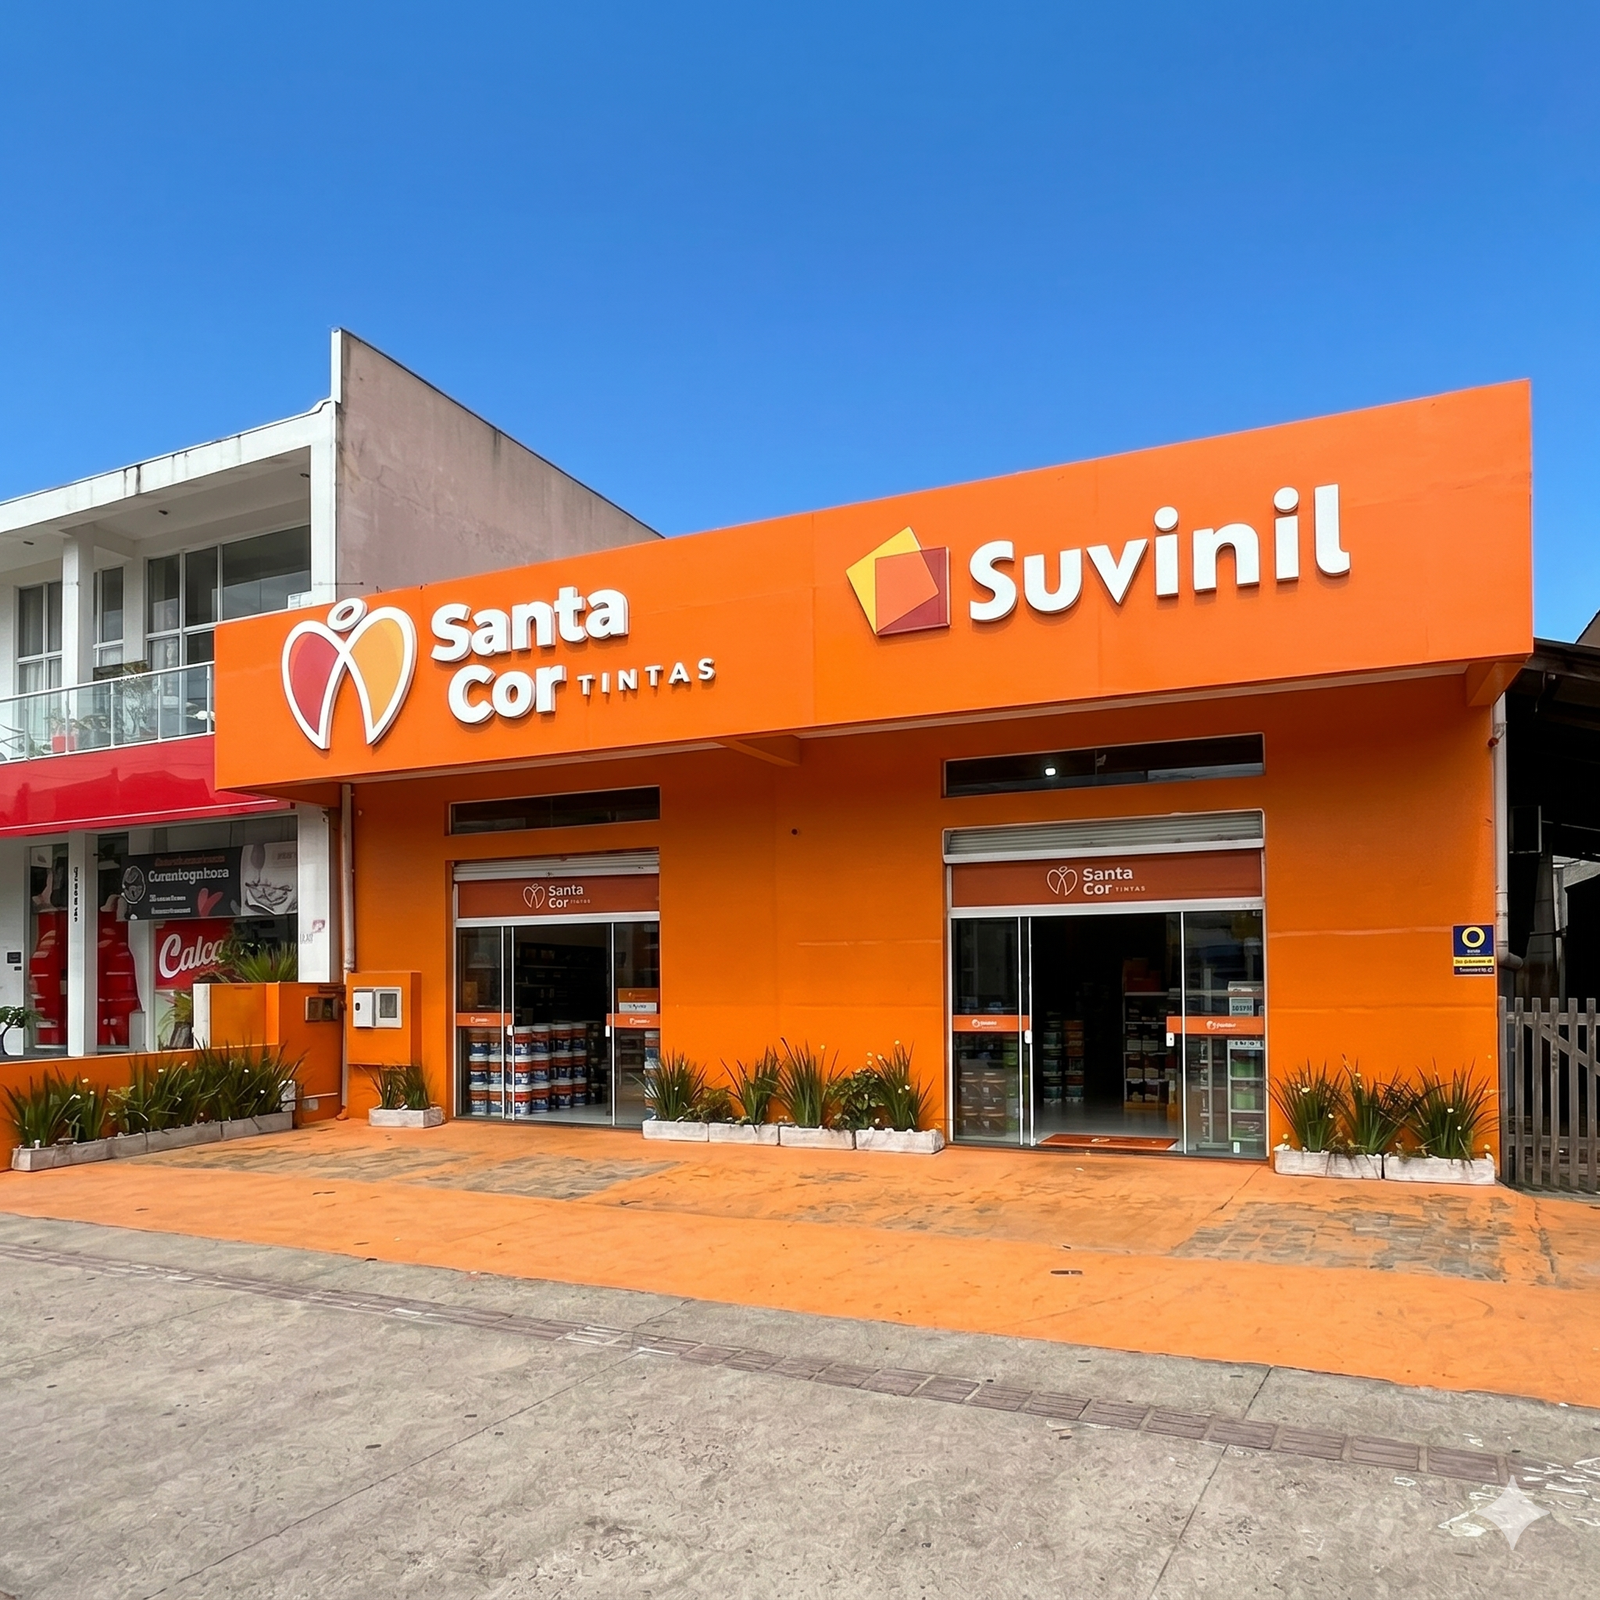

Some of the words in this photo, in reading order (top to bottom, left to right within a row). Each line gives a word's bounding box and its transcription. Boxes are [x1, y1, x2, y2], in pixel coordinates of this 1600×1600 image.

[968, 483, 1352, 622] Suvinil
[430, 586, 630, 662] Santa
[447, 664, 566, 725] Cor
[576, 658, 716, 696] TINTAS
[1082, 866, 1133, 881] Santa
[548, 884, 584, 897] Santa
[1082, 882, 1113, 895] Cor
[548, 897, 569, 909] Cor
